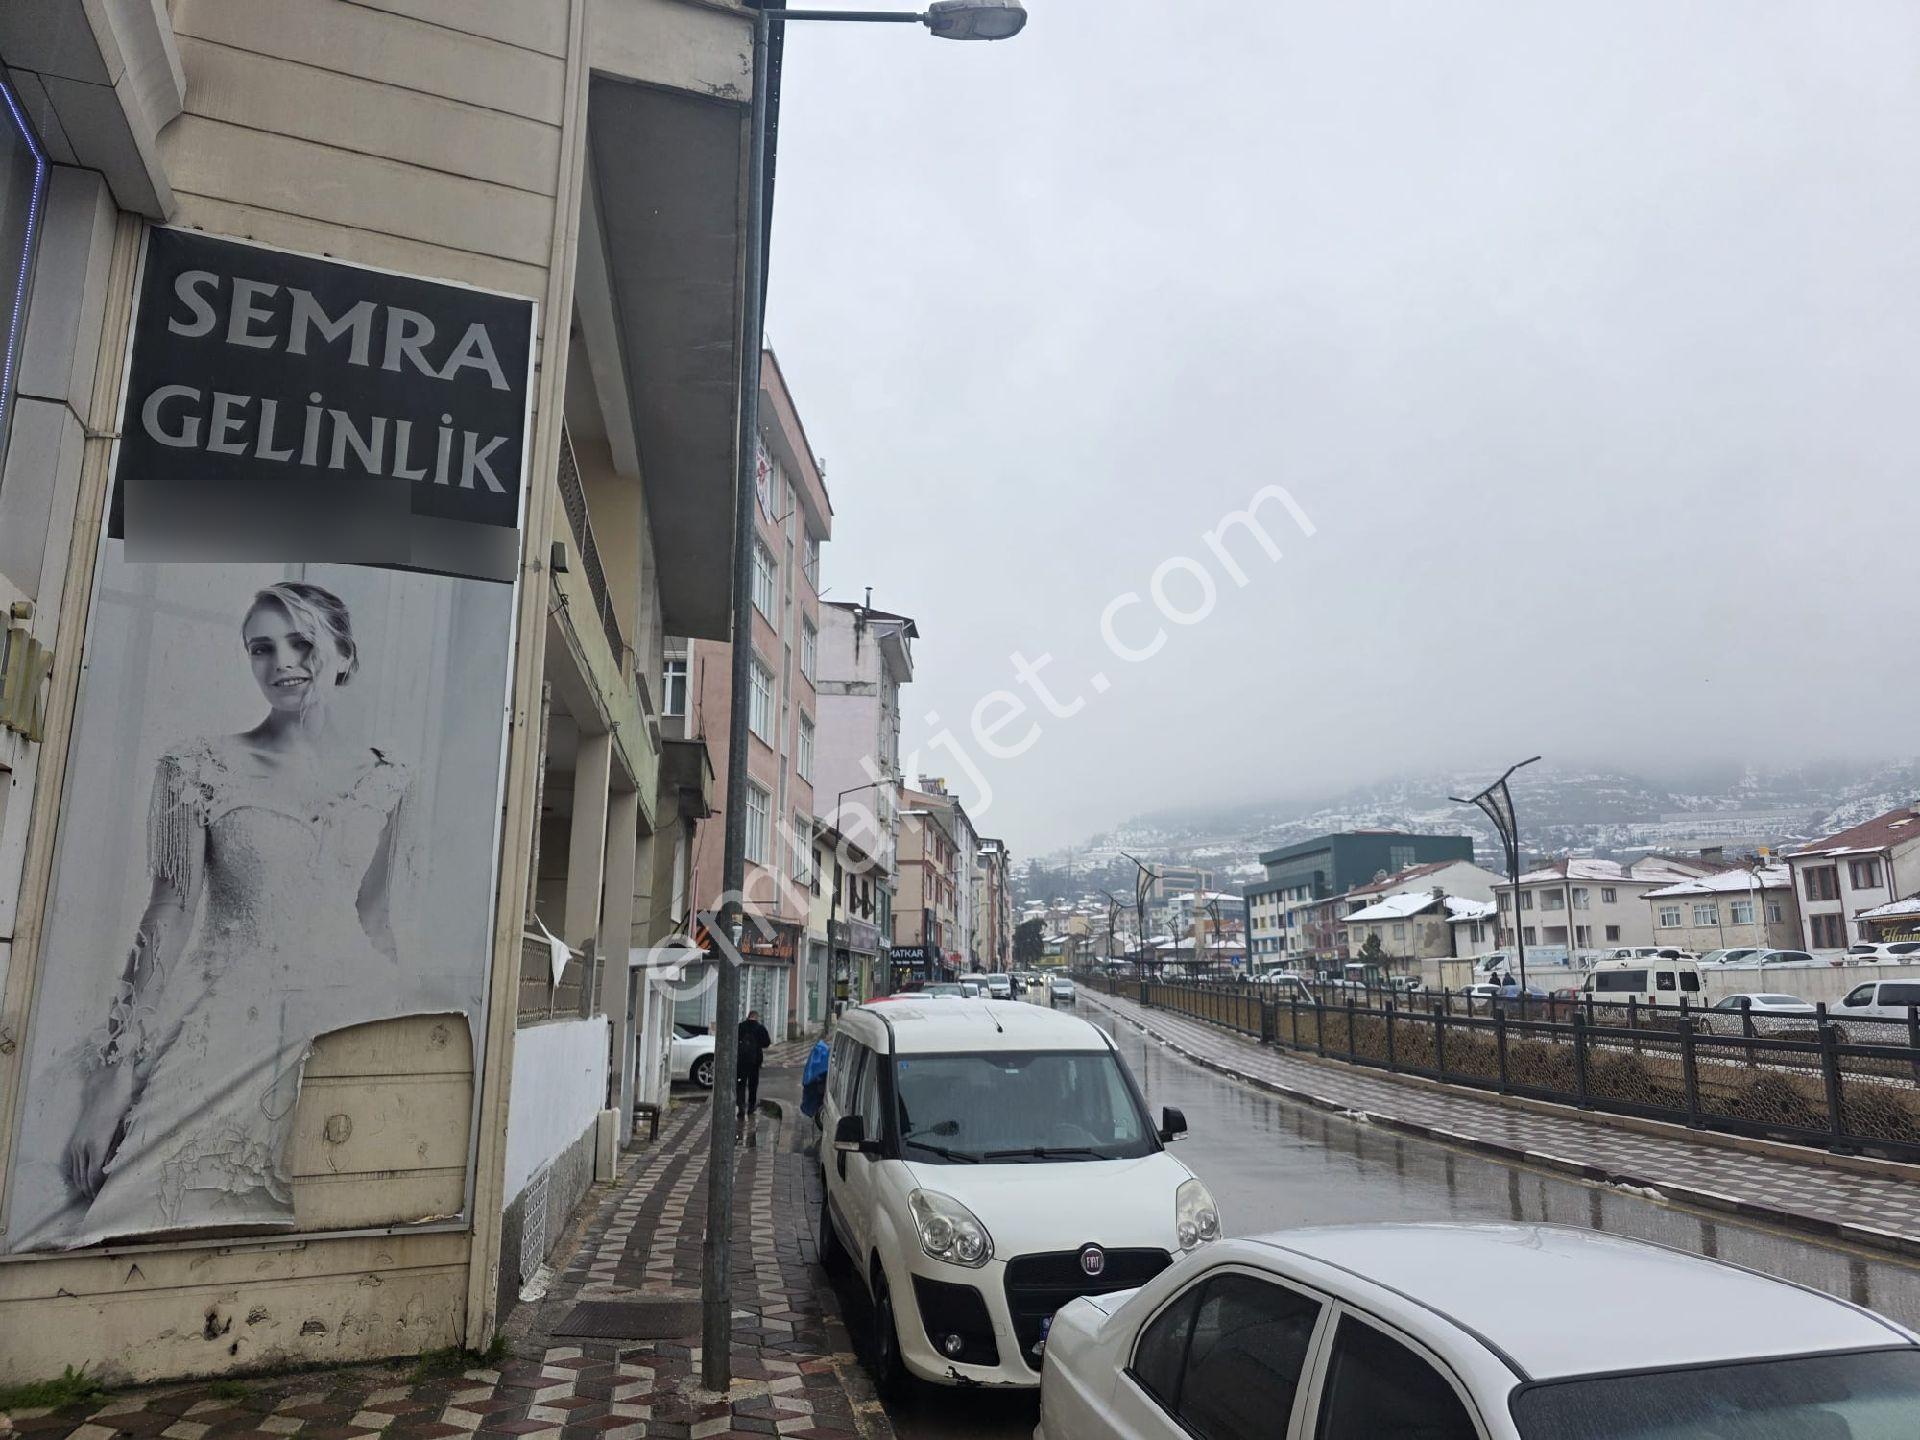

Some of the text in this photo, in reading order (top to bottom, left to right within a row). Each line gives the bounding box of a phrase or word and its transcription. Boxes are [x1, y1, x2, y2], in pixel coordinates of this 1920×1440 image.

[167, 270, 511, 391] SEMRA
[141, 384, 510, 493] GELİNLİK
[1086, 1256, 1099, 1268] FIAT
